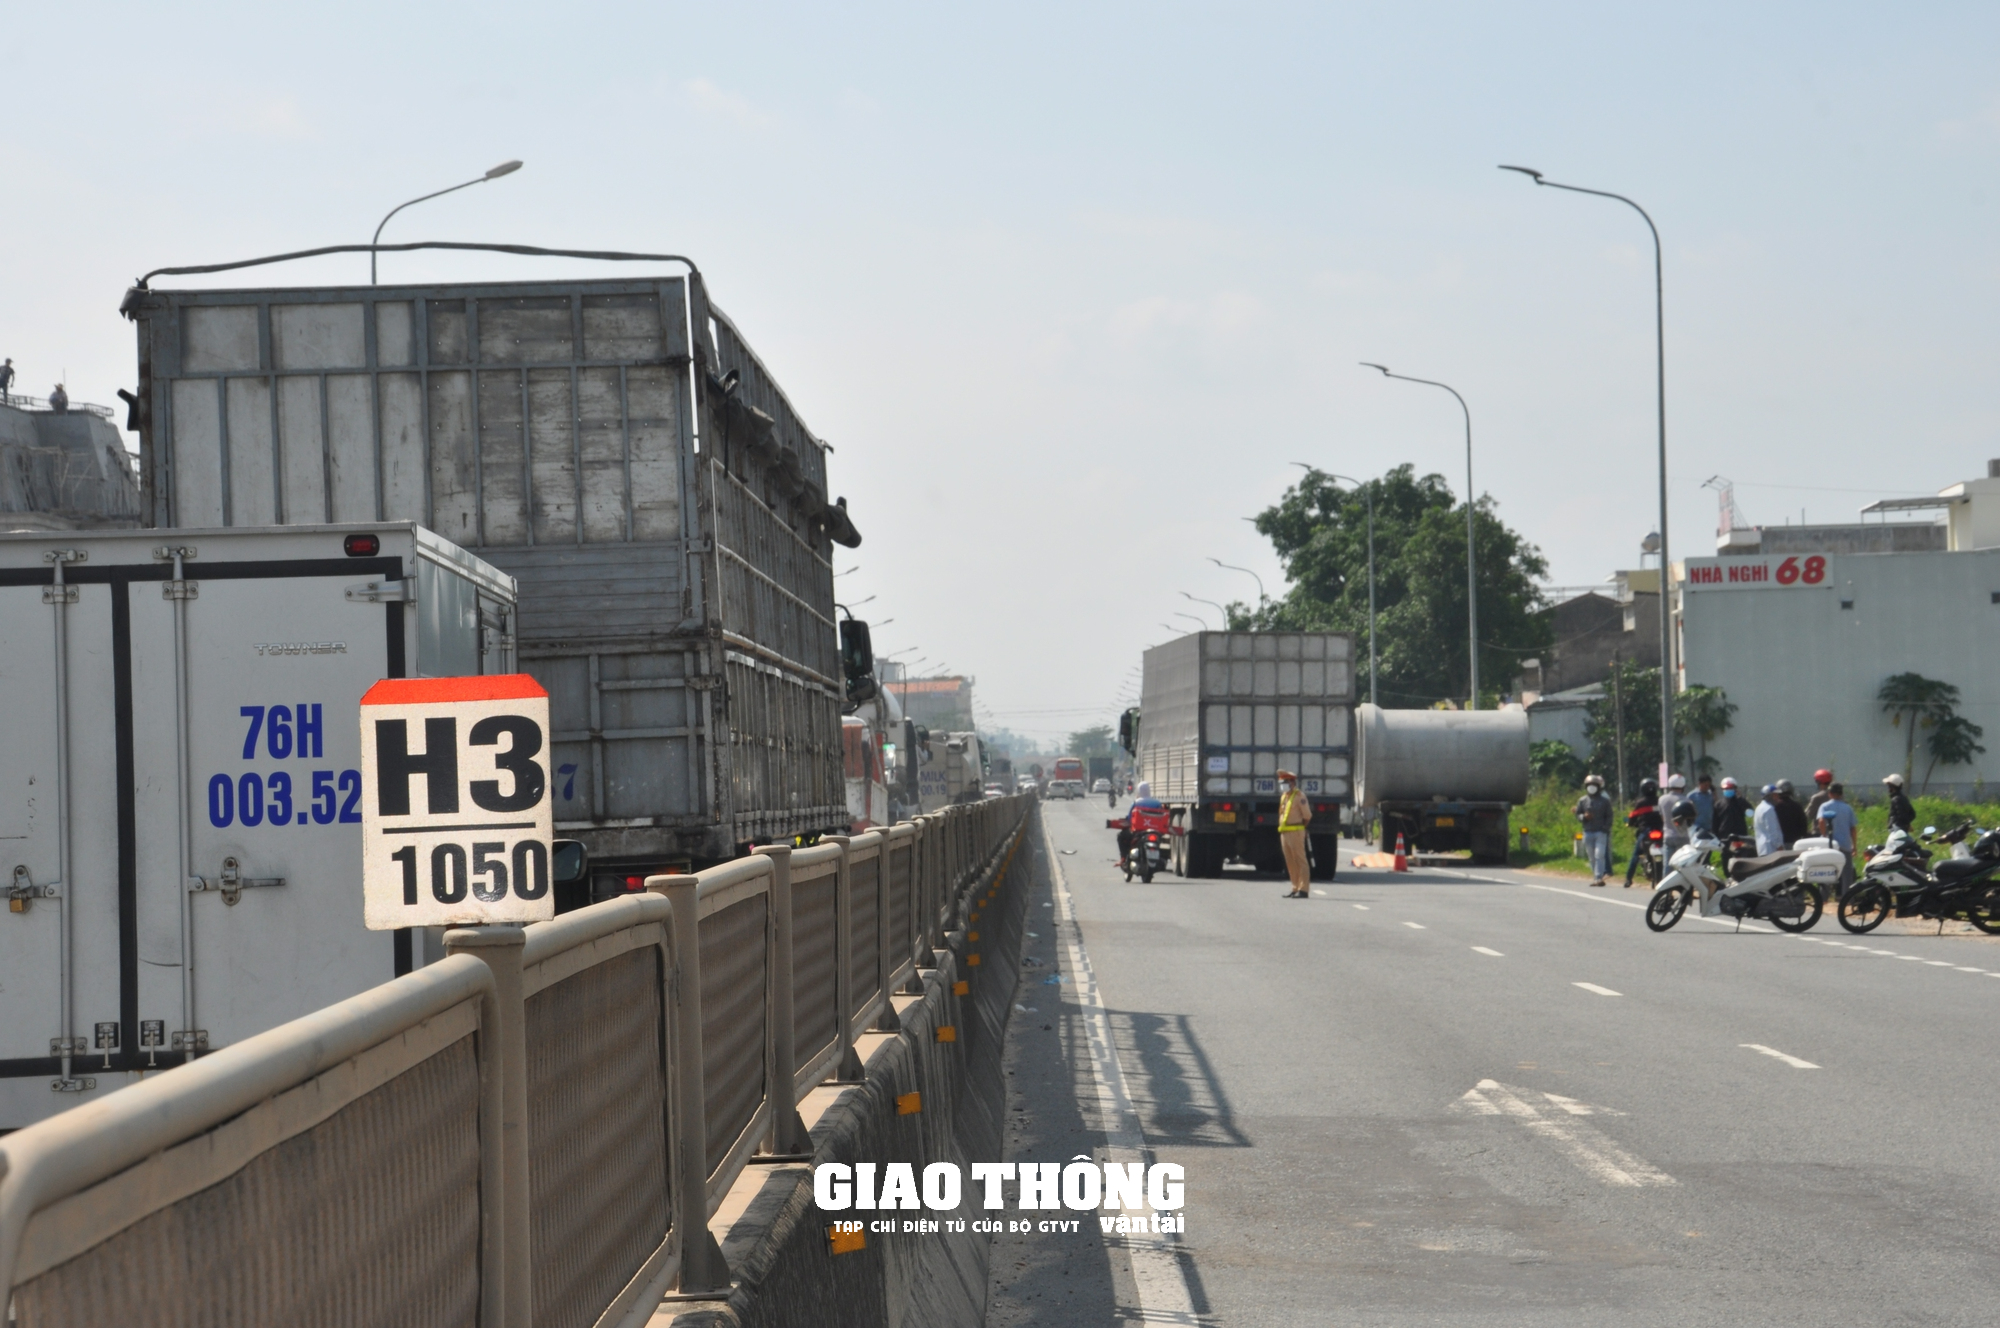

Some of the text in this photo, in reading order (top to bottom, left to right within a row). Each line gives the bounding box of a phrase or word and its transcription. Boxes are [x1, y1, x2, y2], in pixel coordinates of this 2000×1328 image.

[1690, 555, 1826, 585] NHÀ NGHỈ 68
[254, 641, 347, 656] TOWNER
[240, 703, 323, 760] 76H
[375, 715, 545, 817] H3
[1256, 780, 1274, 791] 76H
[208, 769, 363, 828] 003.52
[392, 840, 549, 906] 1050
